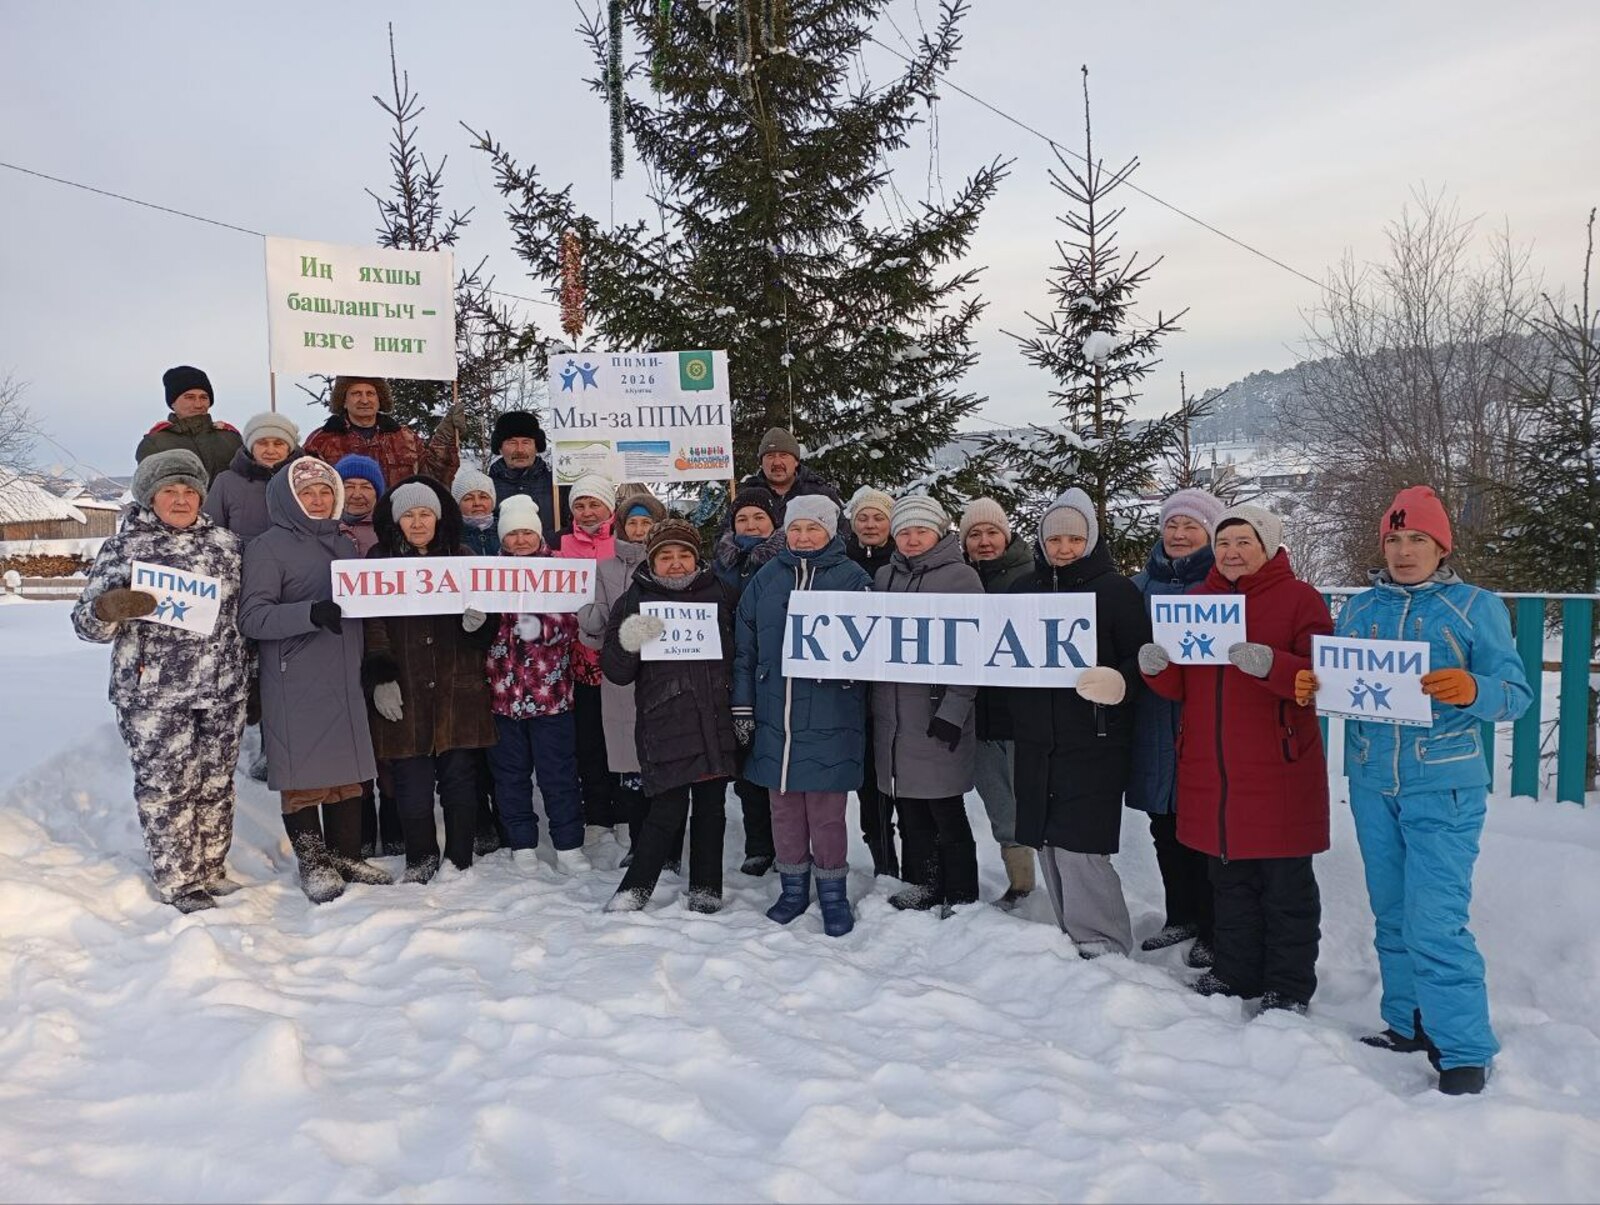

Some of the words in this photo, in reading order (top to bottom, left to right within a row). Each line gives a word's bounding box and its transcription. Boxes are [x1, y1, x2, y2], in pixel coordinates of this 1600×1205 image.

[300, 256, 333, 281] Иң
[359, 266, 421, 286] яхшы
[287, 292, 415, 319] башлангыч
[304, 331, 354, 349] изге
[374, 336, 427, 353] ният
[621, 374, 655, 385] 2026
[553, 406, 633, 430] Мы-за
[636, 404, 727, 427] ППМИ
[137, 568, 217, 600] ППМИ
[336, 570, 408, 597] МЫ
[415, 568, 461, 595] ЗА
[470, 567, 589, 594] ППМИ!
[1155, 603, 1240, 624] ППМИ
[660, 629, 705, 642] 2026
[787, 612, 1092, 669] КУНГАК
[1319, 645, 1422, 675] ППМИ
